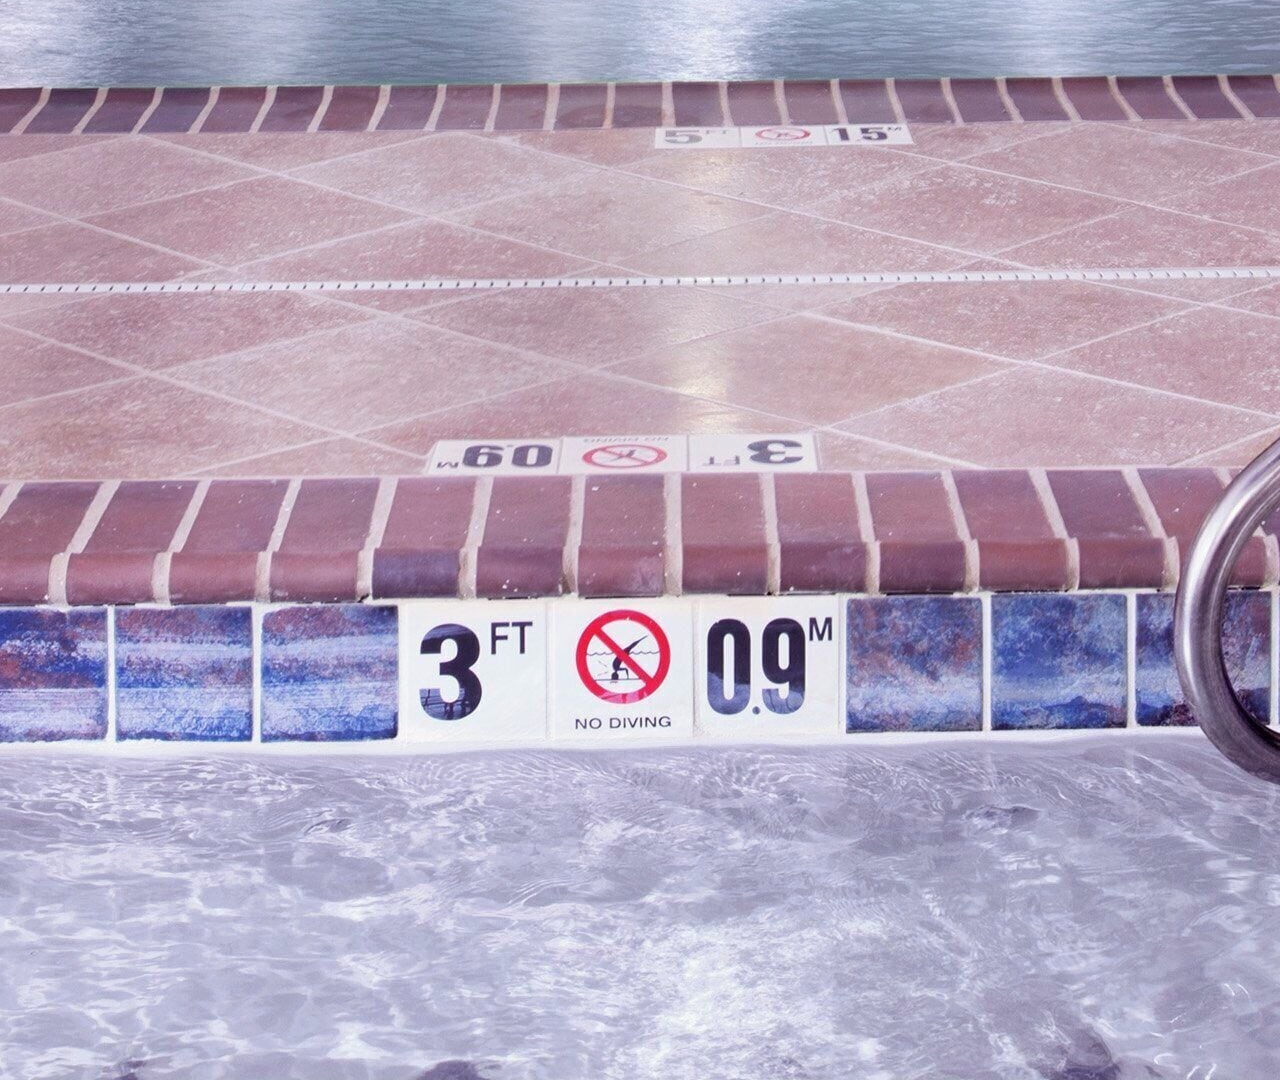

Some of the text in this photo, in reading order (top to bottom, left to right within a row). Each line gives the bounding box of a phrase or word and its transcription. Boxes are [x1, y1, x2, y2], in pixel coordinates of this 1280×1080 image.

[664, 130, 703, 144] 5
[702, 439, 804, 467] 3 FT
[436, 460, 459, 469] M
[419, 621, 533, 721] 3 FT
[706, 616, 833, 716] 0.9 M
[574, 716, 672, 731] NO DIVING
